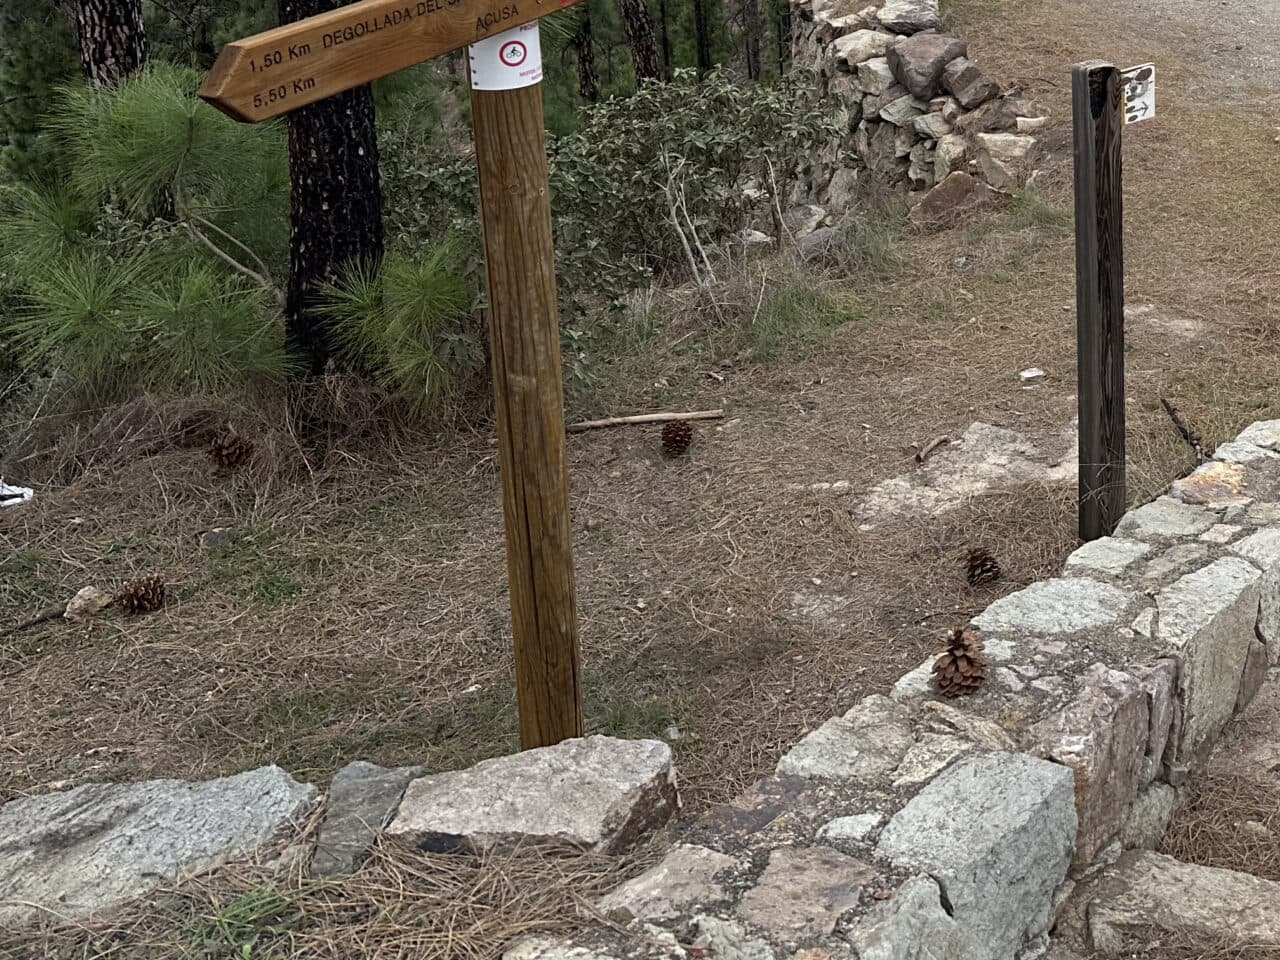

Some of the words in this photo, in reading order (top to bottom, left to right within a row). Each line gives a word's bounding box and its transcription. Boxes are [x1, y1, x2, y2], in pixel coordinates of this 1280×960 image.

[250, 50, 283, 74] 1,50
[288, 42, 311, 61] Km
[322, 6, 413, 50] DEGOLLADA
[252, 86, 288, 109] 5,50
[293, 74, 316, 94] Km
[475, 4, 520, 32] ACUSA
